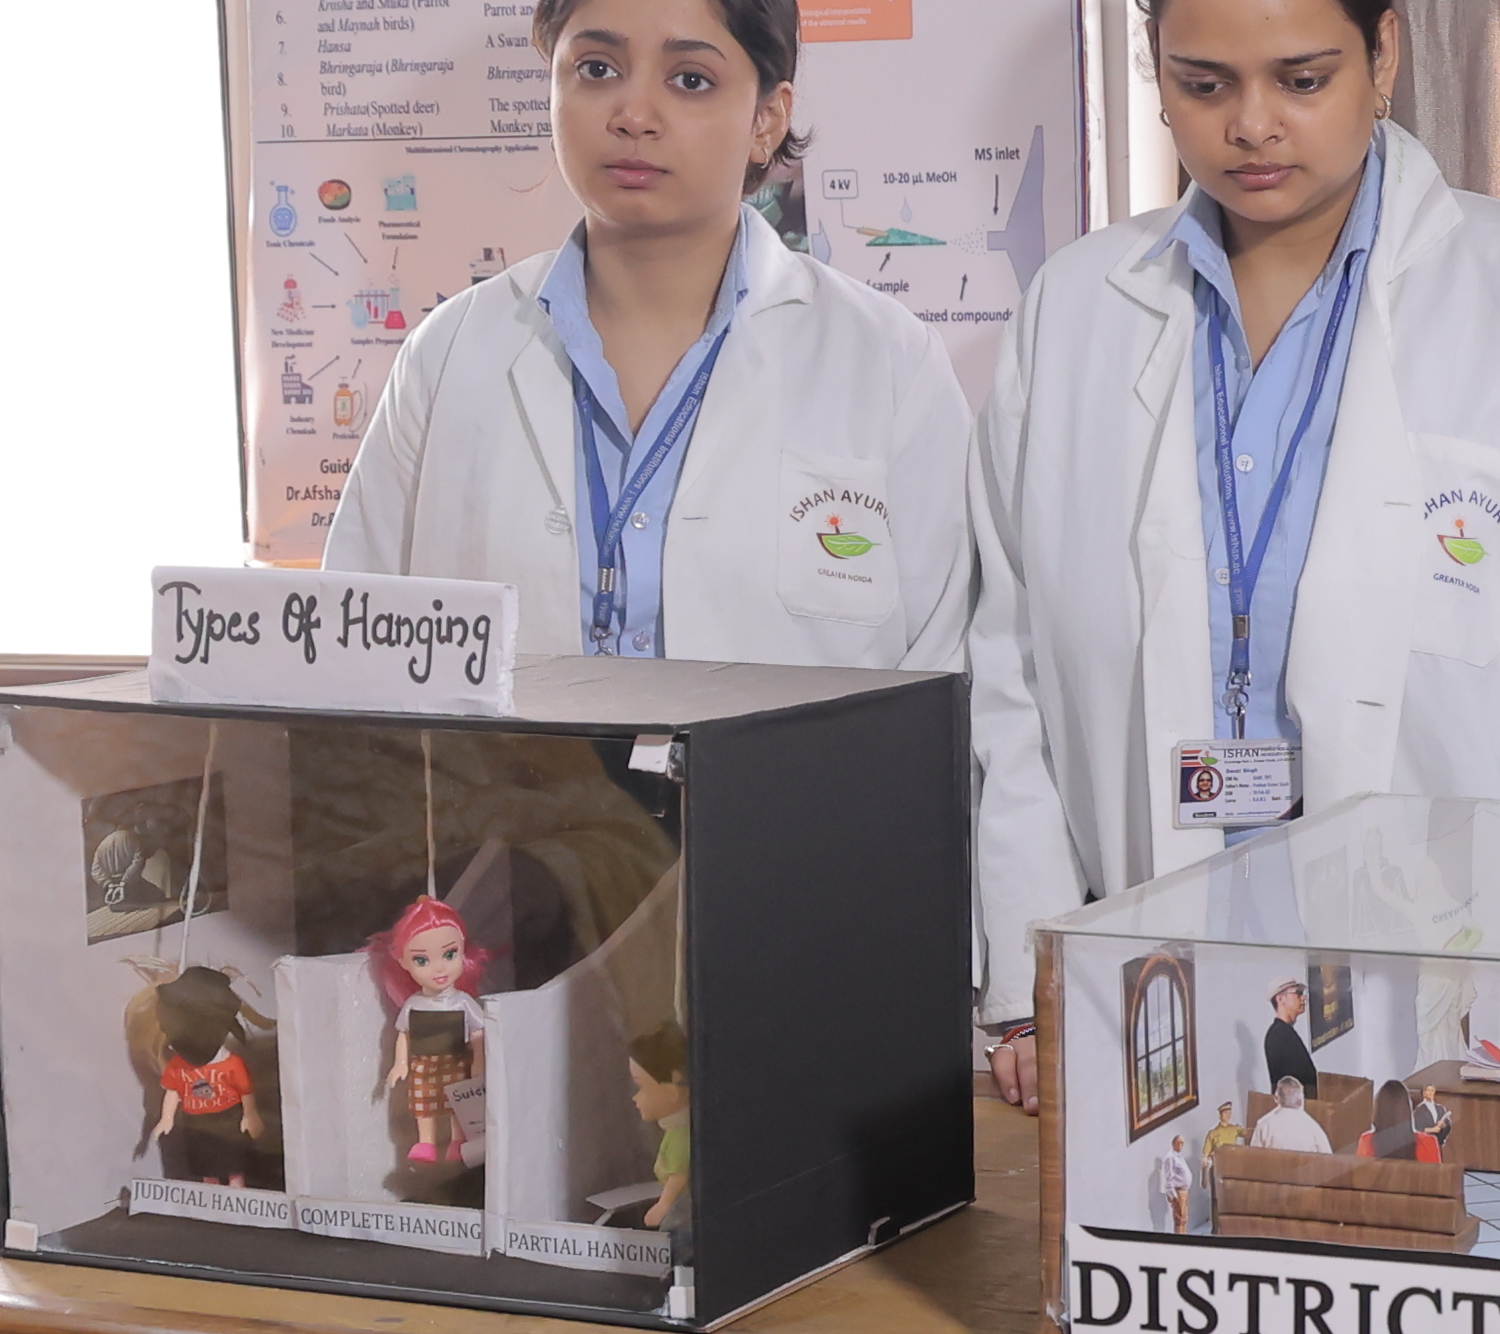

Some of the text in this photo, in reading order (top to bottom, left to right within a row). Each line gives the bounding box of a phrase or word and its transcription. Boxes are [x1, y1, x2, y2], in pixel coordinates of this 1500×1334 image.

[974, 146, 1021, 162] MS inlet
[829, 178, 851, 191] 4 kV
[882, 172, 910, 185] 10-20
[926, 170, 958, 184] MeOH
[789, 488, 836, 523] ISHAN
[157, 579, 493, 687] Types Of Hanging
[131, 1179, 290, 1224] JUDICIAL HANGING
[299, 1203, 484, 1243] COMPLETE HANGING
[506, 1228, 673, 1268] PARTIAL HANGING
